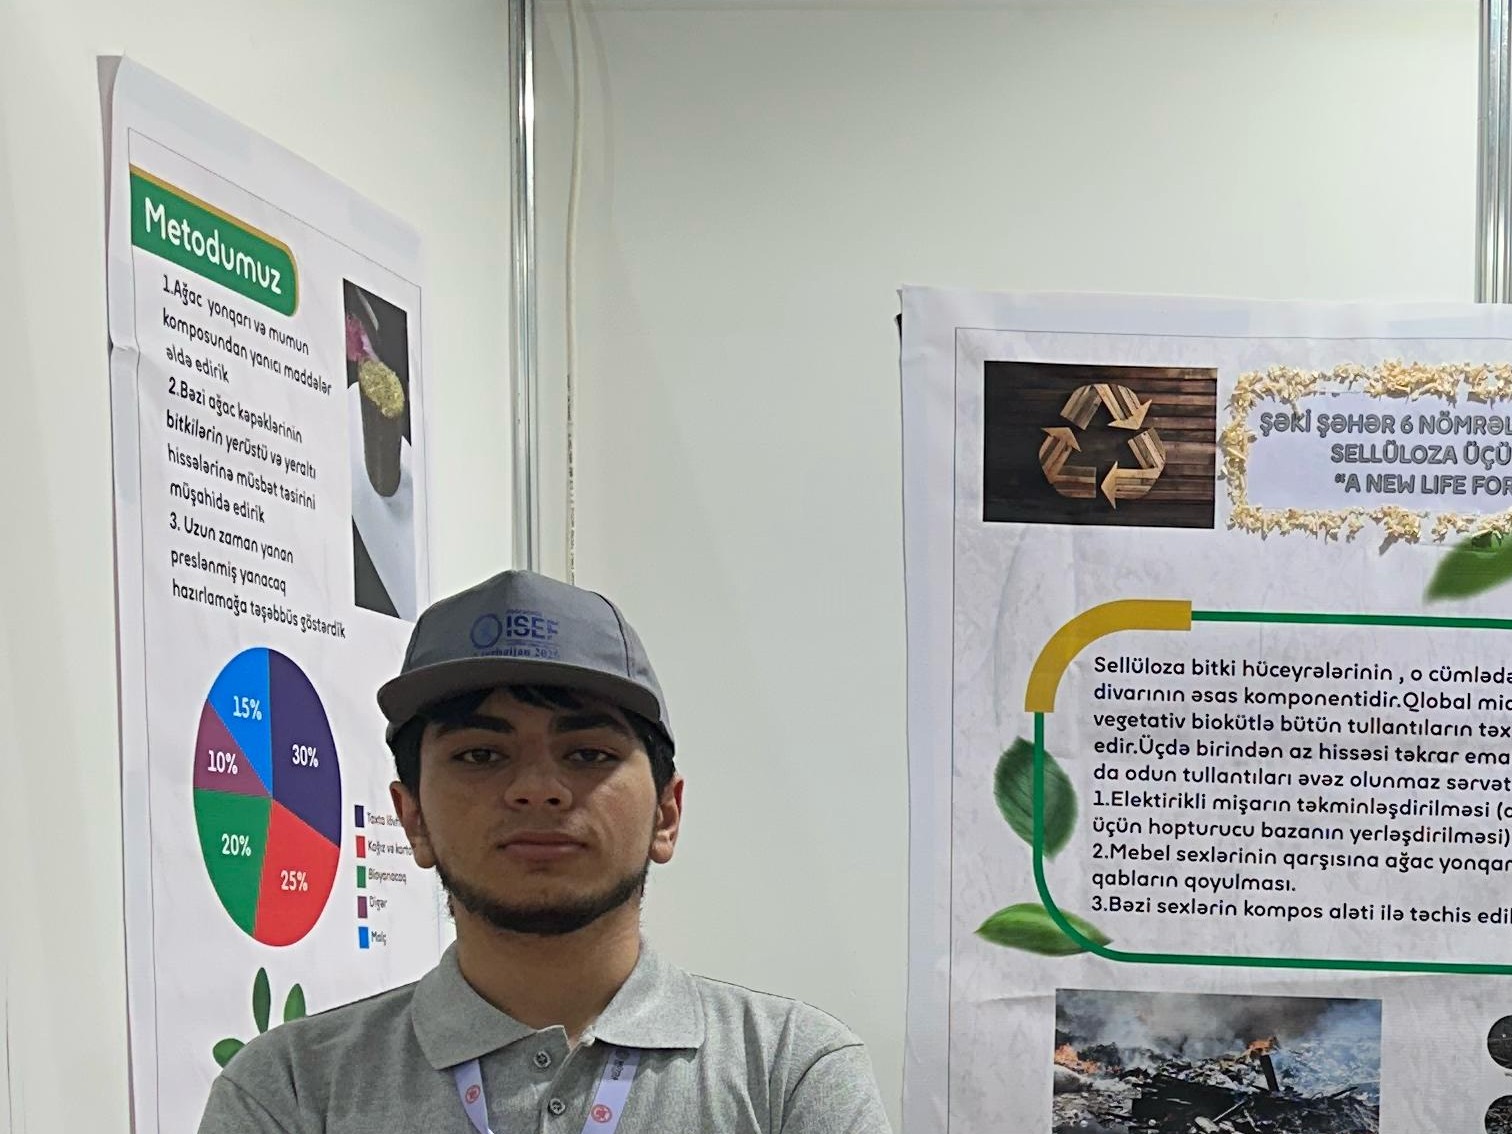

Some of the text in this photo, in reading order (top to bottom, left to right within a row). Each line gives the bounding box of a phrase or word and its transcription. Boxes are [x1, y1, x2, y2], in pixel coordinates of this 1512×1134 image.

[144, 196, 282, 295] Metodumuz
[162, 274, 310, 356] 1.Ağac yonqarı mumun
[163, 307, 332, 397] komposundan yanıcı maddələr
[166, 344, 230, 383] əldə edirik
[168, 377, 303, 444] 2.Bəzi ağac kəpəklərinin
[1259, 409, 1312, 438] ŞƏKİ
[1317, 413, 1395, 438] ŞƏHƏR
[1400, 415, 1414, 435] 6
[166, 409, 317, 480] bitkilərin yerüstü və yeraltı
[1330, 439, 1458, 465] SELLÜLOZA
[167, 443, 316, 511] hissələrinə müsbət təsirini
[1366, 474, 1416, 494] NEW
[1421, 476, 1466, 495] LIFE
[170, 481, 265, 524] müşahidə edirik
[169, 511, 294, 564] 3. Uzun zaman yanan
[171, 549, 287, 597] preslənmiş yanacaq
[173, 578, 346, 639] hazırlamağa təşəbbüs göstərdik
[507, 614, 558, 640] ISEF
[1094, 656, 1185, 676] Sellüloza
[1192, 658, 1236, 677] bitki
[1242, 659, 1392, 684] hüceyrələrinin
[233, 695, 262, 721] 15%
[1094, 683, 1185, 702] divarının
[1191, 690, 1238, 703] əsas
[1244, 687, 1471, 712] komponentidir.Qlobal
[1094, 711, 1185, 732] vegetativ
[1192, 713, 1275, 731] biokütlə
[1280, 714, 1342, 733] bütün
[1348, 718, 1473, 736] tullantıların
[207, 750, 238, 775] 10%
[291, 744, 319, 768] 30%
[1094, 735, 1191, 760] edir.Üçdə
[1196, 740, 1284, 759] birindən
[1290, 746, 1313, 759] az
[1319, 743, 1388, 761] hissəsi
[1394, 747, 1459, 763] təkrar
[1094, 765, 1119, 781] da
[1125, 766, 1177, 783] odun
[1183, 769, 1292, 786] tullantıları
[1298, 774, 1344, 787] əvəz
[1350, 772, 1440, 789] olunmaz
[1093, 790, 1206, 810] 1.Elektirikli
[1212, 793, 1291, 815] mişarın
[1298, 796, 1490, 819] təkminləşdirilməsi
[221, 833, 252, 857] 20%
[1093, 818, 1511, 847] üçün hopturucu bazanın yerləşdirilməsi)
[1092, 844, 1170, 862] 2.Mebel
[1176, 846, 1276, 865] sexlərinin
[1283, 849, 1379, 870] qarşısına
[1385, 851, 1433, 872] ağac
[280, 870, 308, 892] 25%
[1092, 870, 1296, 895] qabların qoyulması.
[1092, 895, 1150, 913] 3.Bəzi
[1157, 897, 1238, 917] sexlərin
[1244, 900, 1323, 921] kompos
[1329, 903, 1374, 921] aləti
[1381, 904, 1404, 921] ilə
[1410, 905, 1471, 925] təchis
